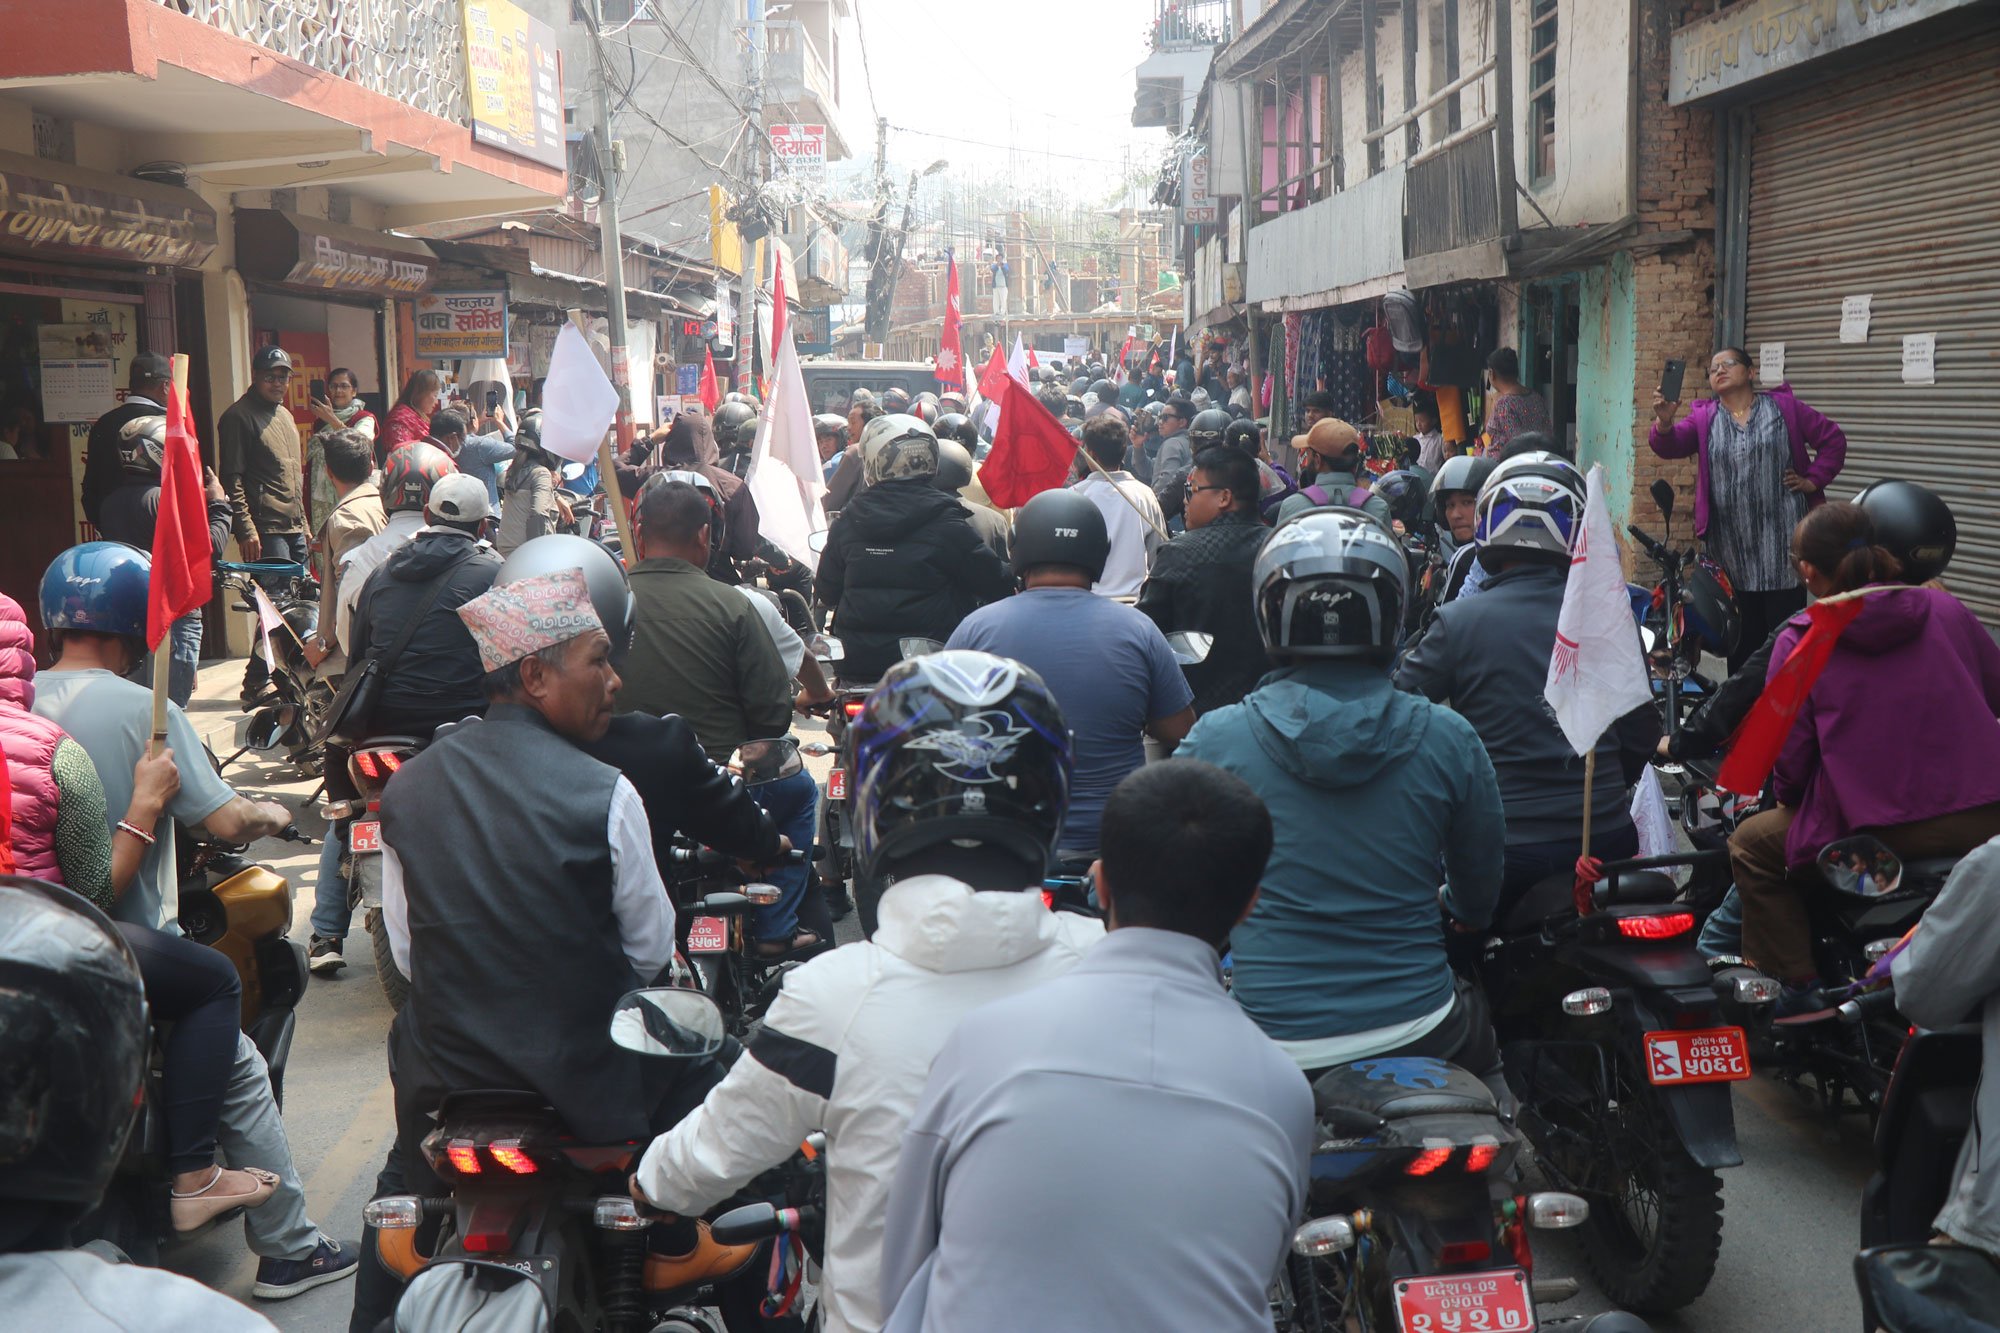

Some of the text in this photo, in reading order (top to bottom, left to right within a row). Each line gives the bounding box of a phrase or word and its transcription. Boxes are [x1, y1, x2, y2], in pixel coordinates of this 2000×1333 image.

[773, 136, 822, 156] दियालो
[419, 313, 451, 330] वाच
[1055, 527, 1079, 537] TVS
[1692, 1036, 1709, 1046] प्रदेश
[1690, 1044, 1732, 1058] ०४२प
[1684, 1056, 1743, 1075] ५०६८
[1424, 1280, 1498, 1297] प्रदेश १-०२
[1441, 1296, 1484, 1309] ०५०प
[1412, 1307, 1521, 1333] २५२७
